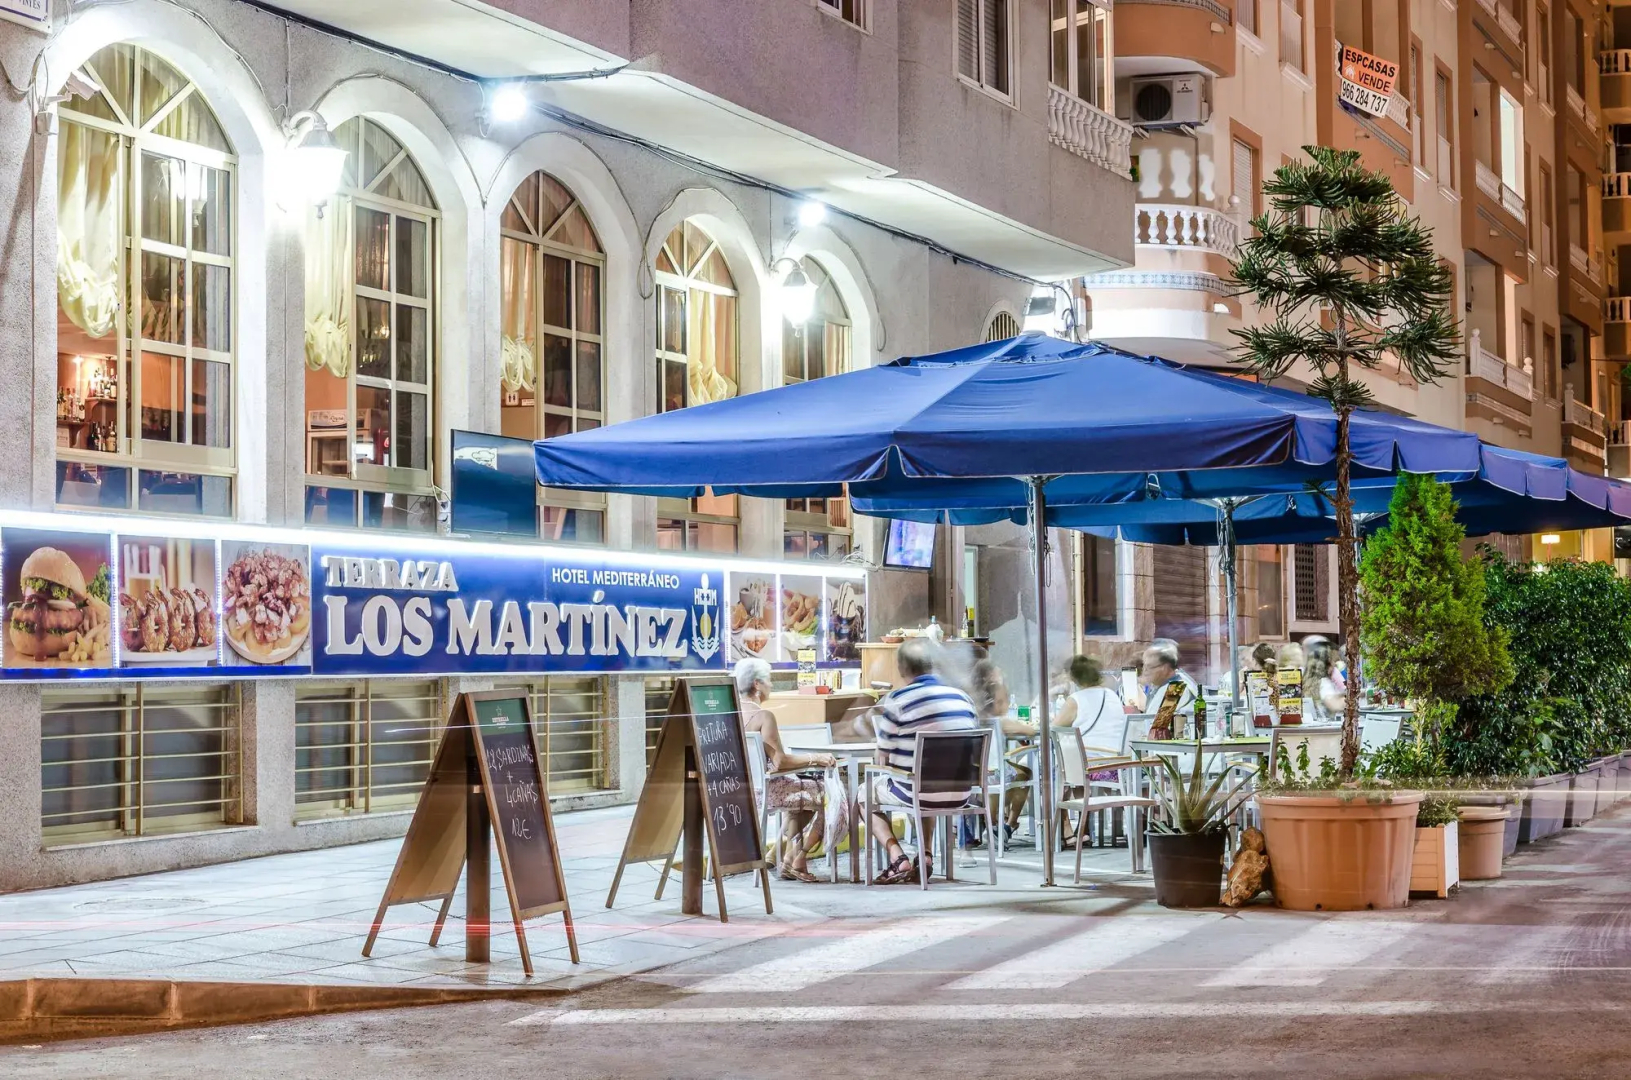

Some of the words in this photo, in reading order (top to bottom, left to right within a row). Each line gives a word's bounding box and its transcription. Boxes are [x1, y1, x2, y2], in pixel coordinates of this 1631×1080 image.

[1345, 49, 1396, 78] ESPCASAS
[1358, 71, 1391, 93] VENDE
[1342, 81, 1355, 101] 966
[1355, 87, 1369, 106] 284
[1370, 94, 1387, 114] 737
[321, 555, 459, 592] TERRAZA
[552, 568, 590, 585] HOTEL
[593, 569, 680, 589] MEDITERRÁNEO
[323, 595, 434, 657] LOS
[446, 590, 688, 658] MARTÍNEZ
[702, 750, 737, 775] VARIADA
